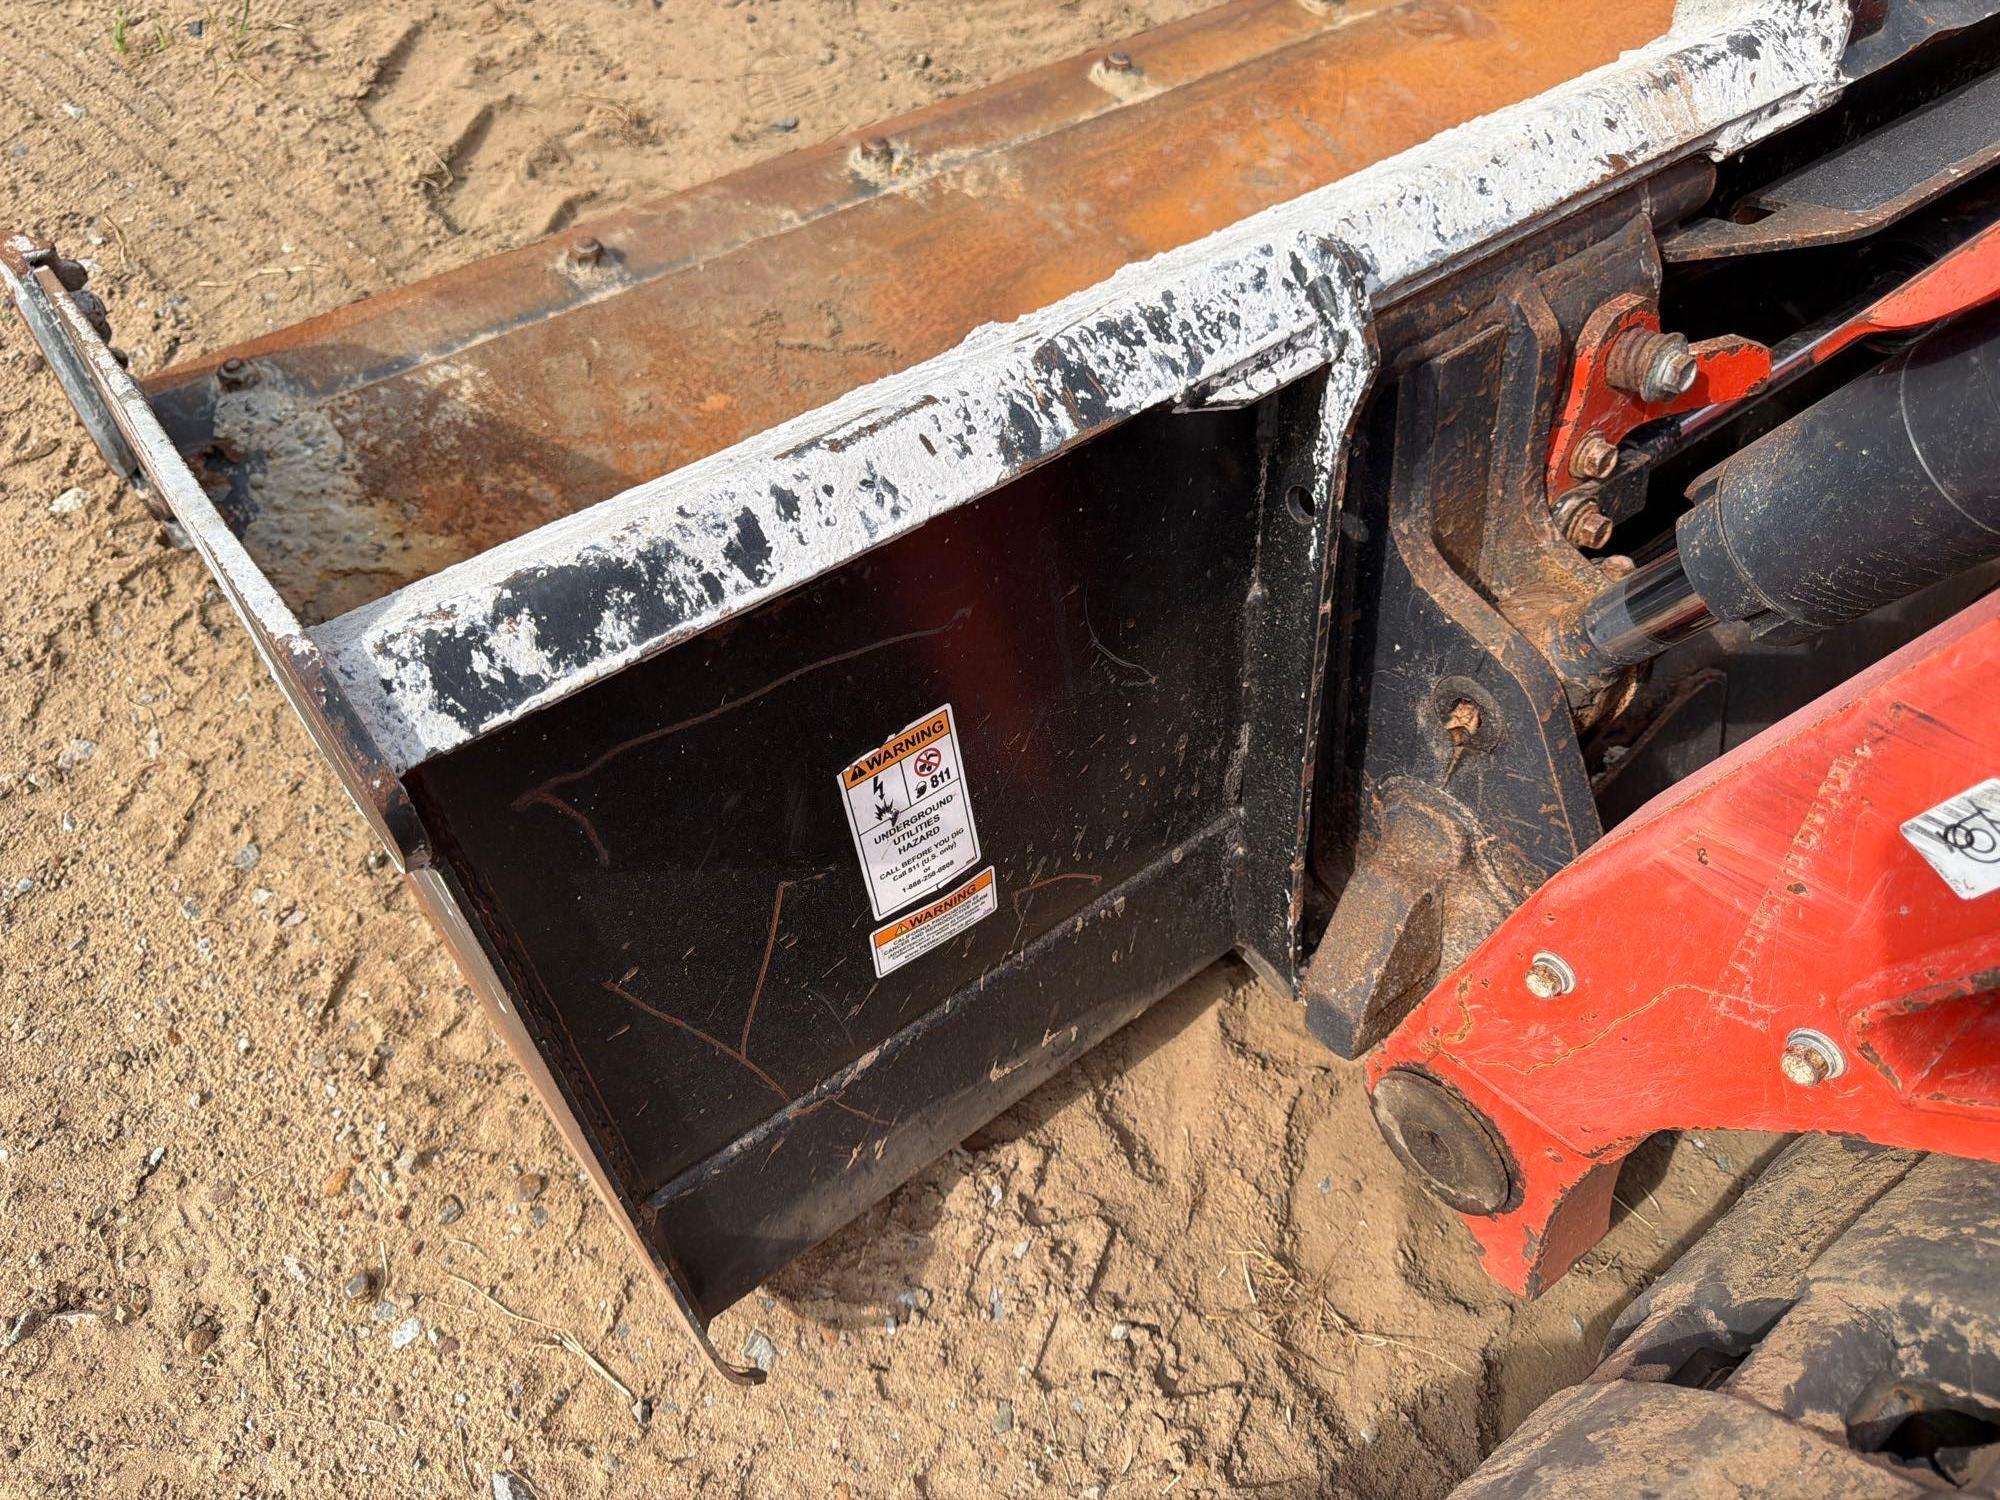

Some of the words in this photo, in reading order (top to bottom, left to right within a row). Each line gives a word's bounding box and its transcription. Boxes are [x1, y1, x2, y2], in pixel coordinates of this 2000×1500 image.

[867, 719, 944, 770] WARNING
[930, 766, 951, 789] 811
[874, 793, 954, 845] UNDERGROUND
[891, 813, 940, 845] UTILITIES
[898, 826, 940, 855] HAZARD
[879, 866, 900, 880] CALL
[902, 847, 933, 867] BEFORE
[934, 836, 951, 849] YOU
[951, 827, 964, 839] DIG
[893, 870, 907, 882] Call
[908, 863, 920, 873] 811
[921, 852, 937, 867] (U.S.
[940, 841, 957, 855] only)
[883, 938, 909, 955] CANCER
[910, 930, 923, 941] AND
[924, 903, 970, 933] REPRODUCTIVE
[971, 892, 987, 906] HARM
[893, 923, 931, 945] CALIFORNIA
[931, 898, 971, 925] PROPOSITION
[909, 883, 977, 928] WARNING
